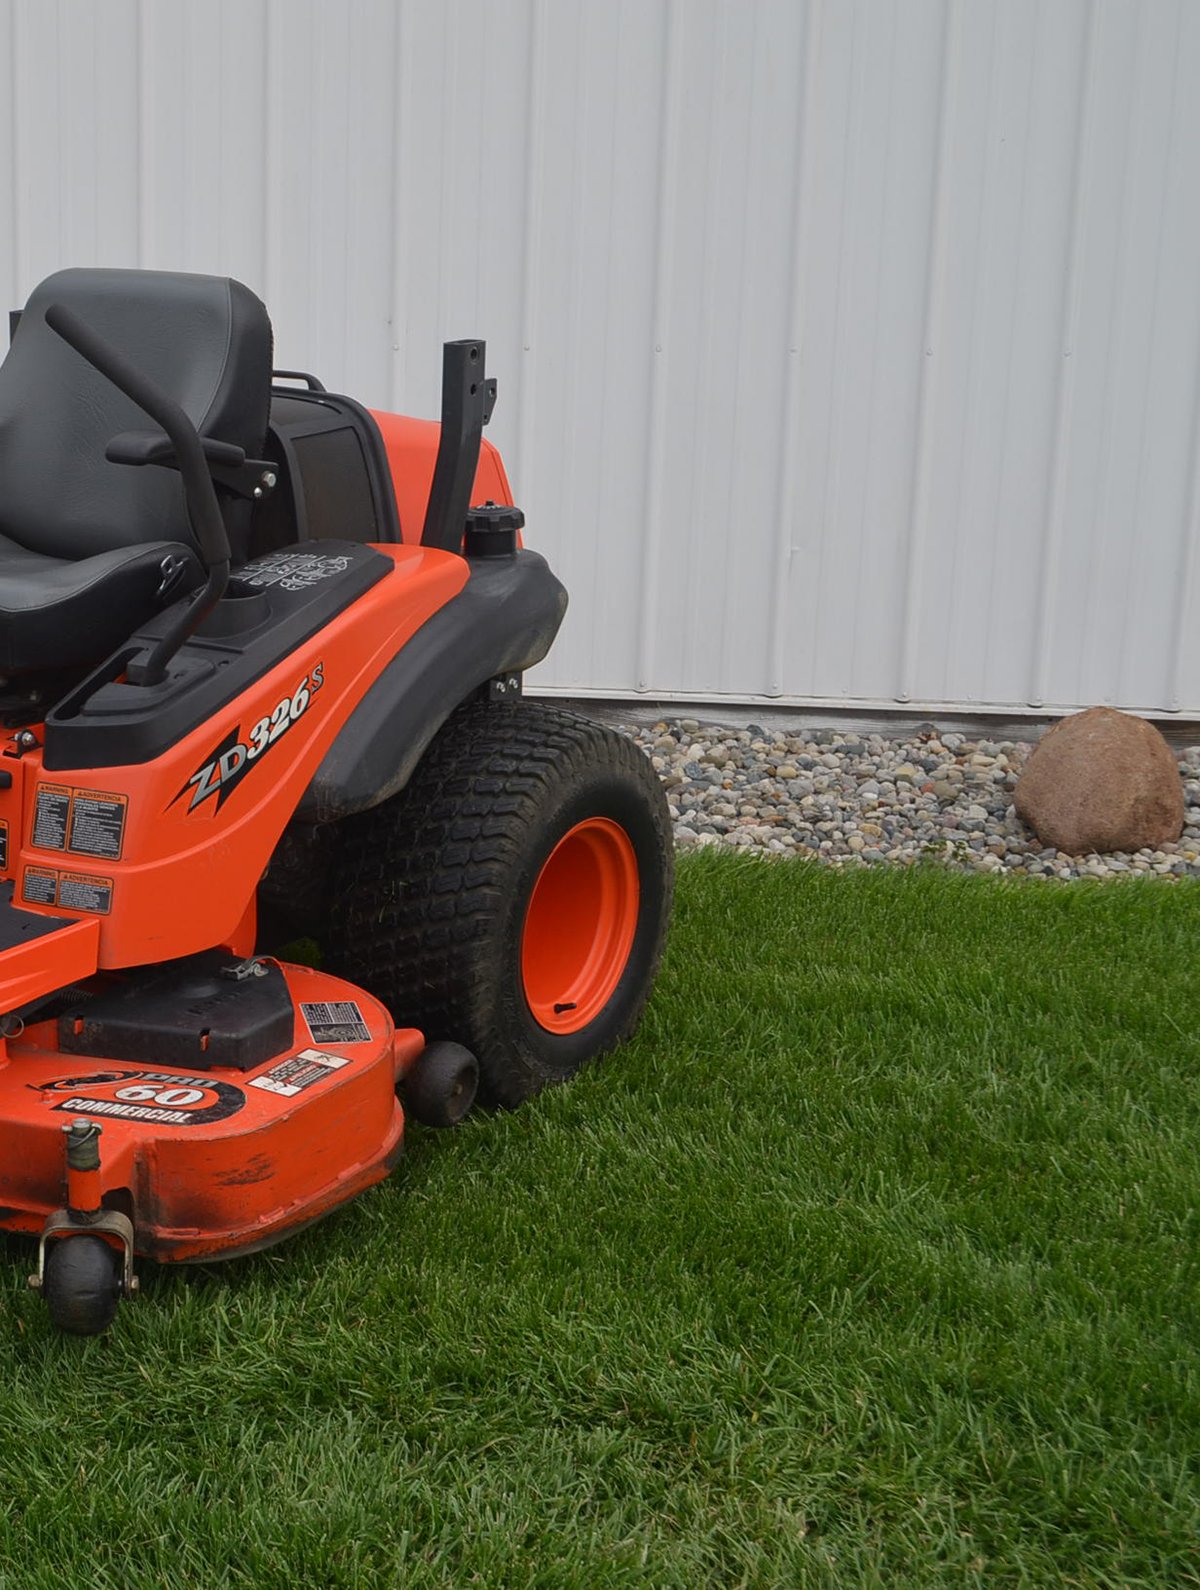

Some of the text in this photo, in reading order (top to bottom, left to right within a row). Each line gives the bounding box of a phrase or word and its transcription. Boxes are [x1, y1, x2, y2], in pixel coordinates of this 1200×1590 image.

[141, 1073, 219, 1089] PRO
[115, 1084, 204, 1107] 60
[61, 1097, 193, 1124] COMMERCIAL
